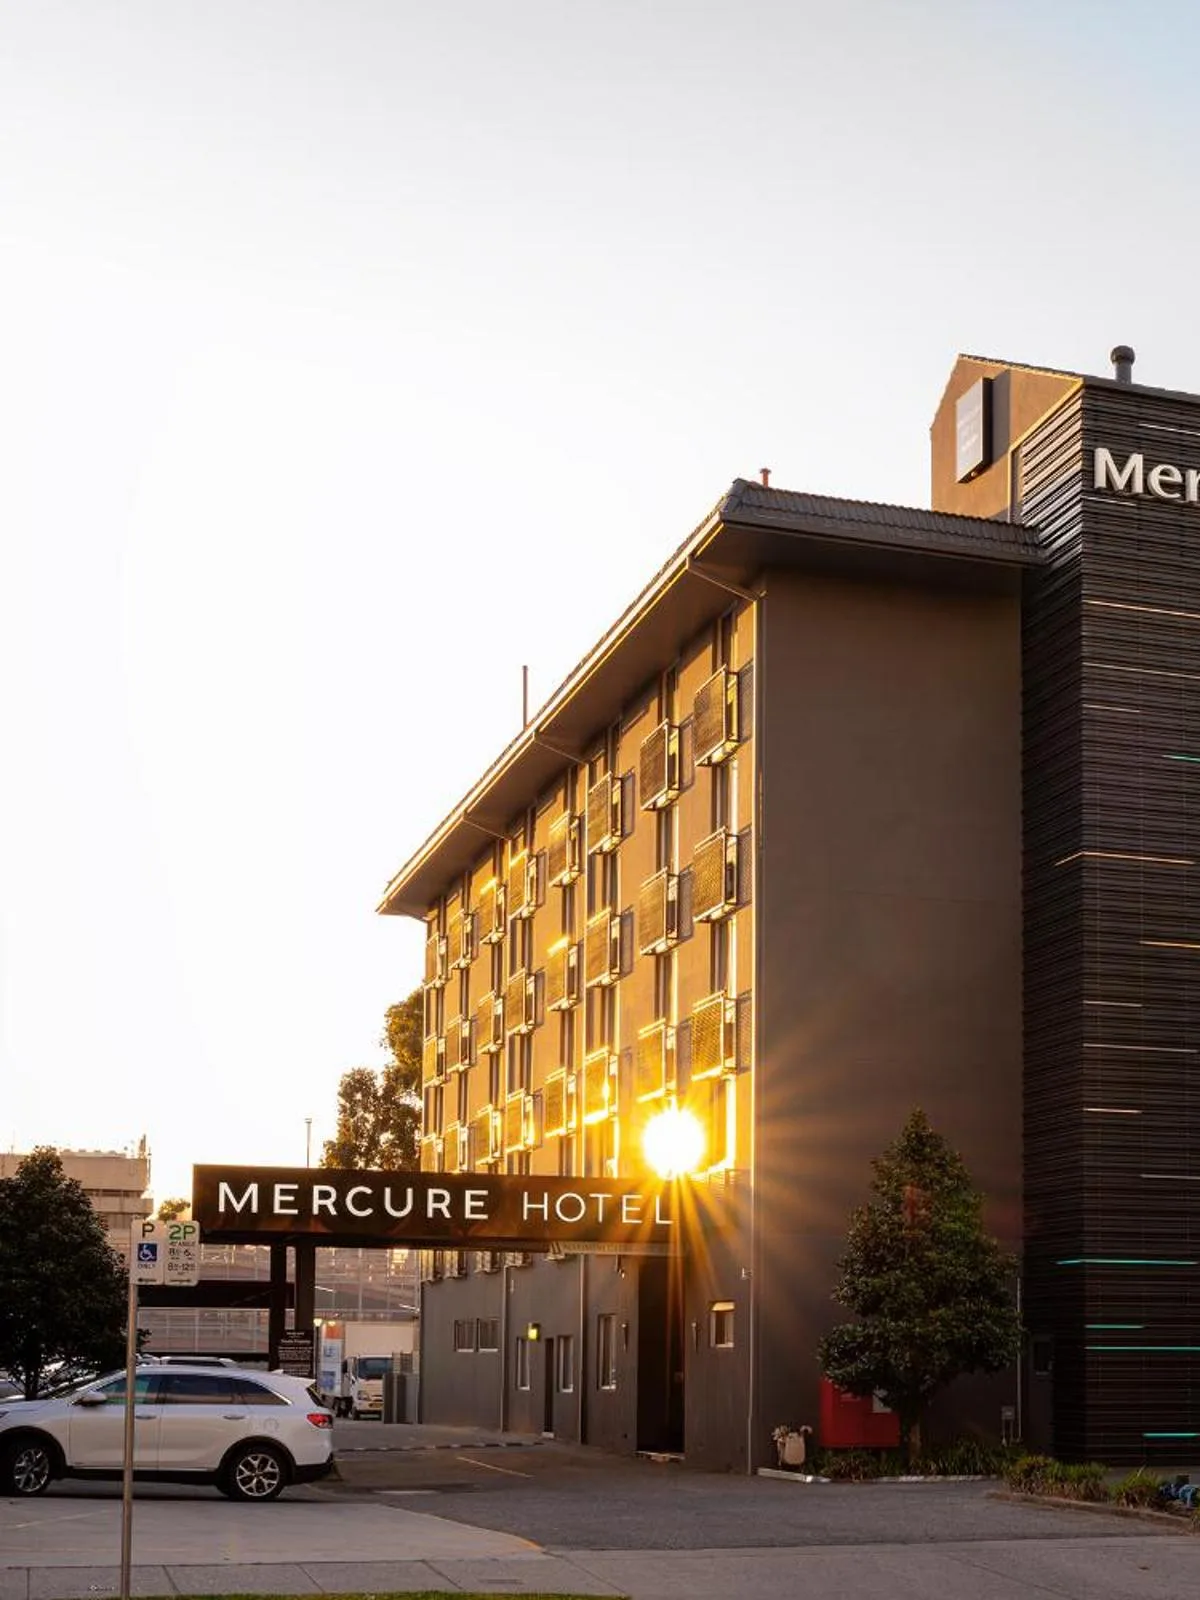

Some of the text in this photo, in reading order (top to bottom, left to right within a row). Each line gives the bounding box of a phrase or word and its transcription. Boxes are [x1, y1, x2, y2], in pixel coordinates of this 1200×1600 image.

[218, 1181, 674, 1225] MERCURE HOTEL
[142, 1223, 154, 1238] P
[169, 1225, 196, 1240] 2P
